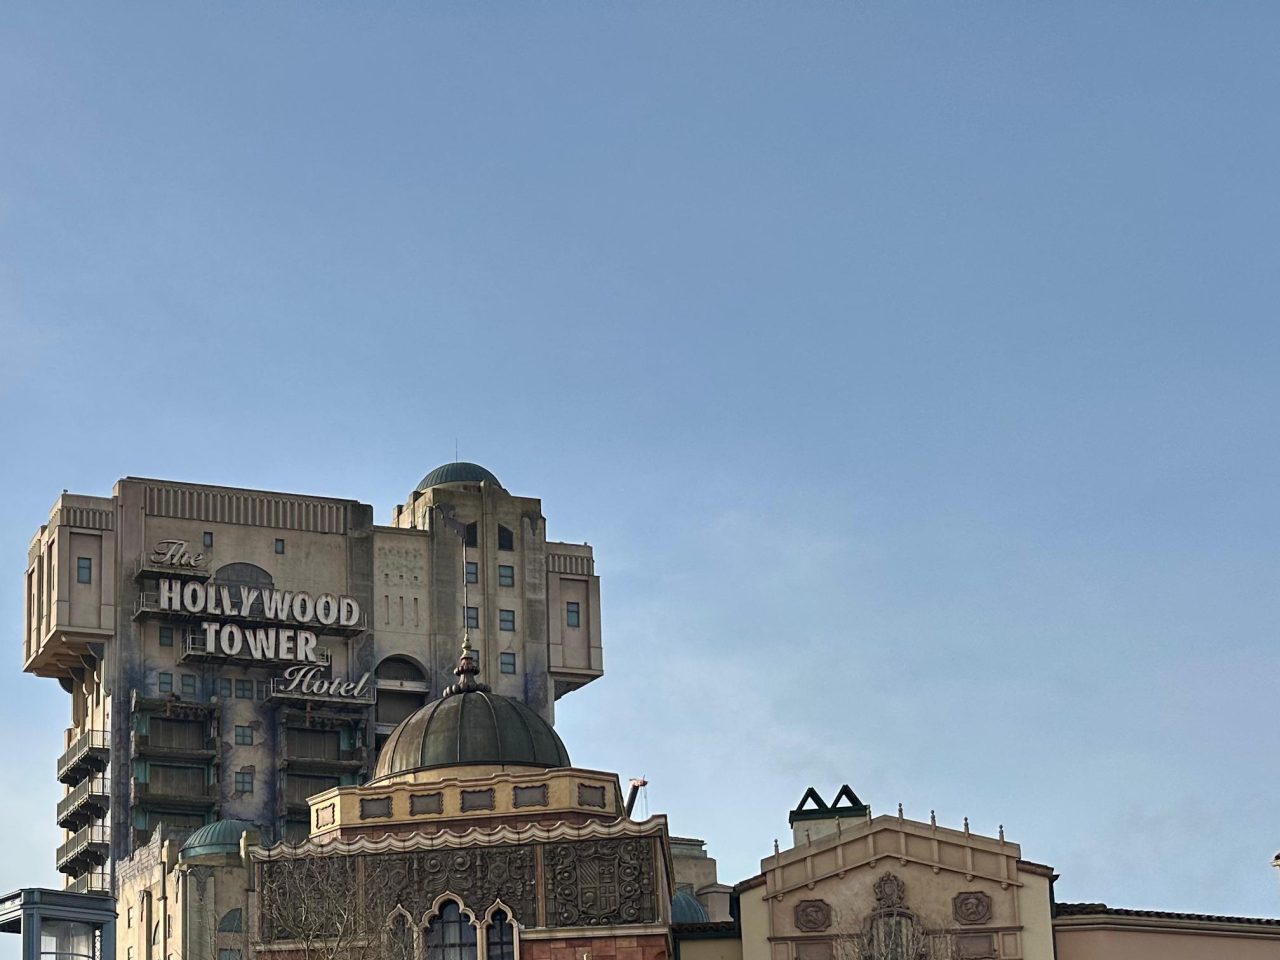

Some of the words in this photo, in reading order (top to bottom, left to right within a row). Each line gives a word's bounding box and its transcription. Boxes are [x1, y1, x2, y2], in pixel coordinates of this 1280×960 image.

[150, 539, 204, 568] The
[158, 578, 361, 627] HOLLYWOOD
[201, 622, 318, 663] TOWER
[279, 665, 371, 698] Hotel
